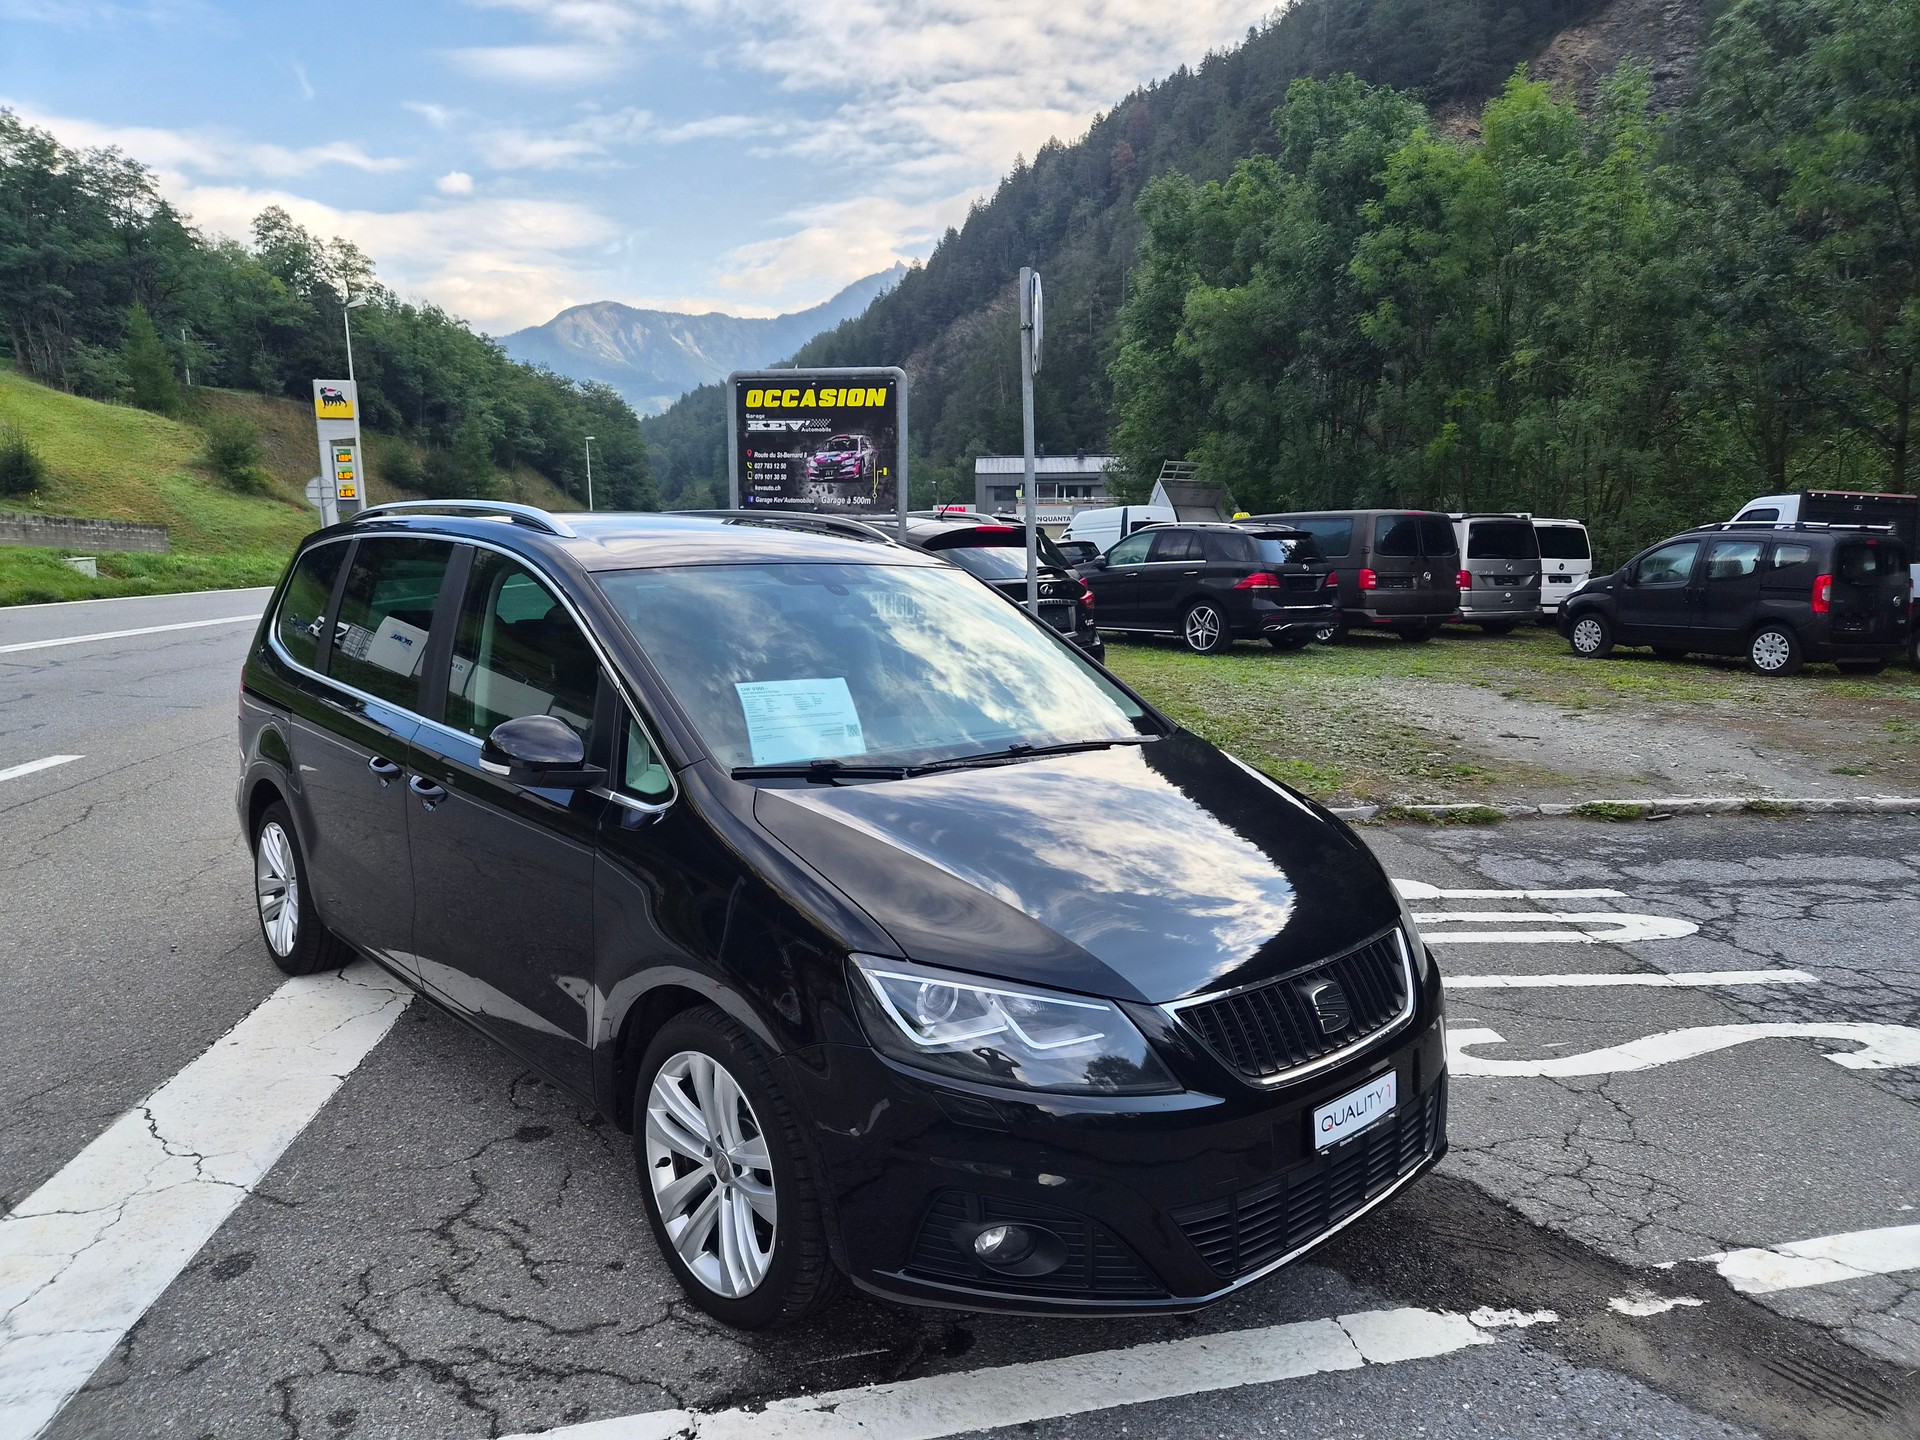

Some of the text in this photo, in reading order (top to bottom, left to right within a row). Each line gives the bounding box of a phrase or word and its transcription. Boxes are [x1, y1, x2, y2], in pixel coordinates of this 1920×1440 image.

[745, 388, 887, 408] OCCASION
[754, 451, 769, 459] Route
[777, 451, 804, 459] St-Bernard
[755, 496, 773, 504] Garage
[821, 496, 846, 506] Garage
[852, 496, 871, 505] 500m
